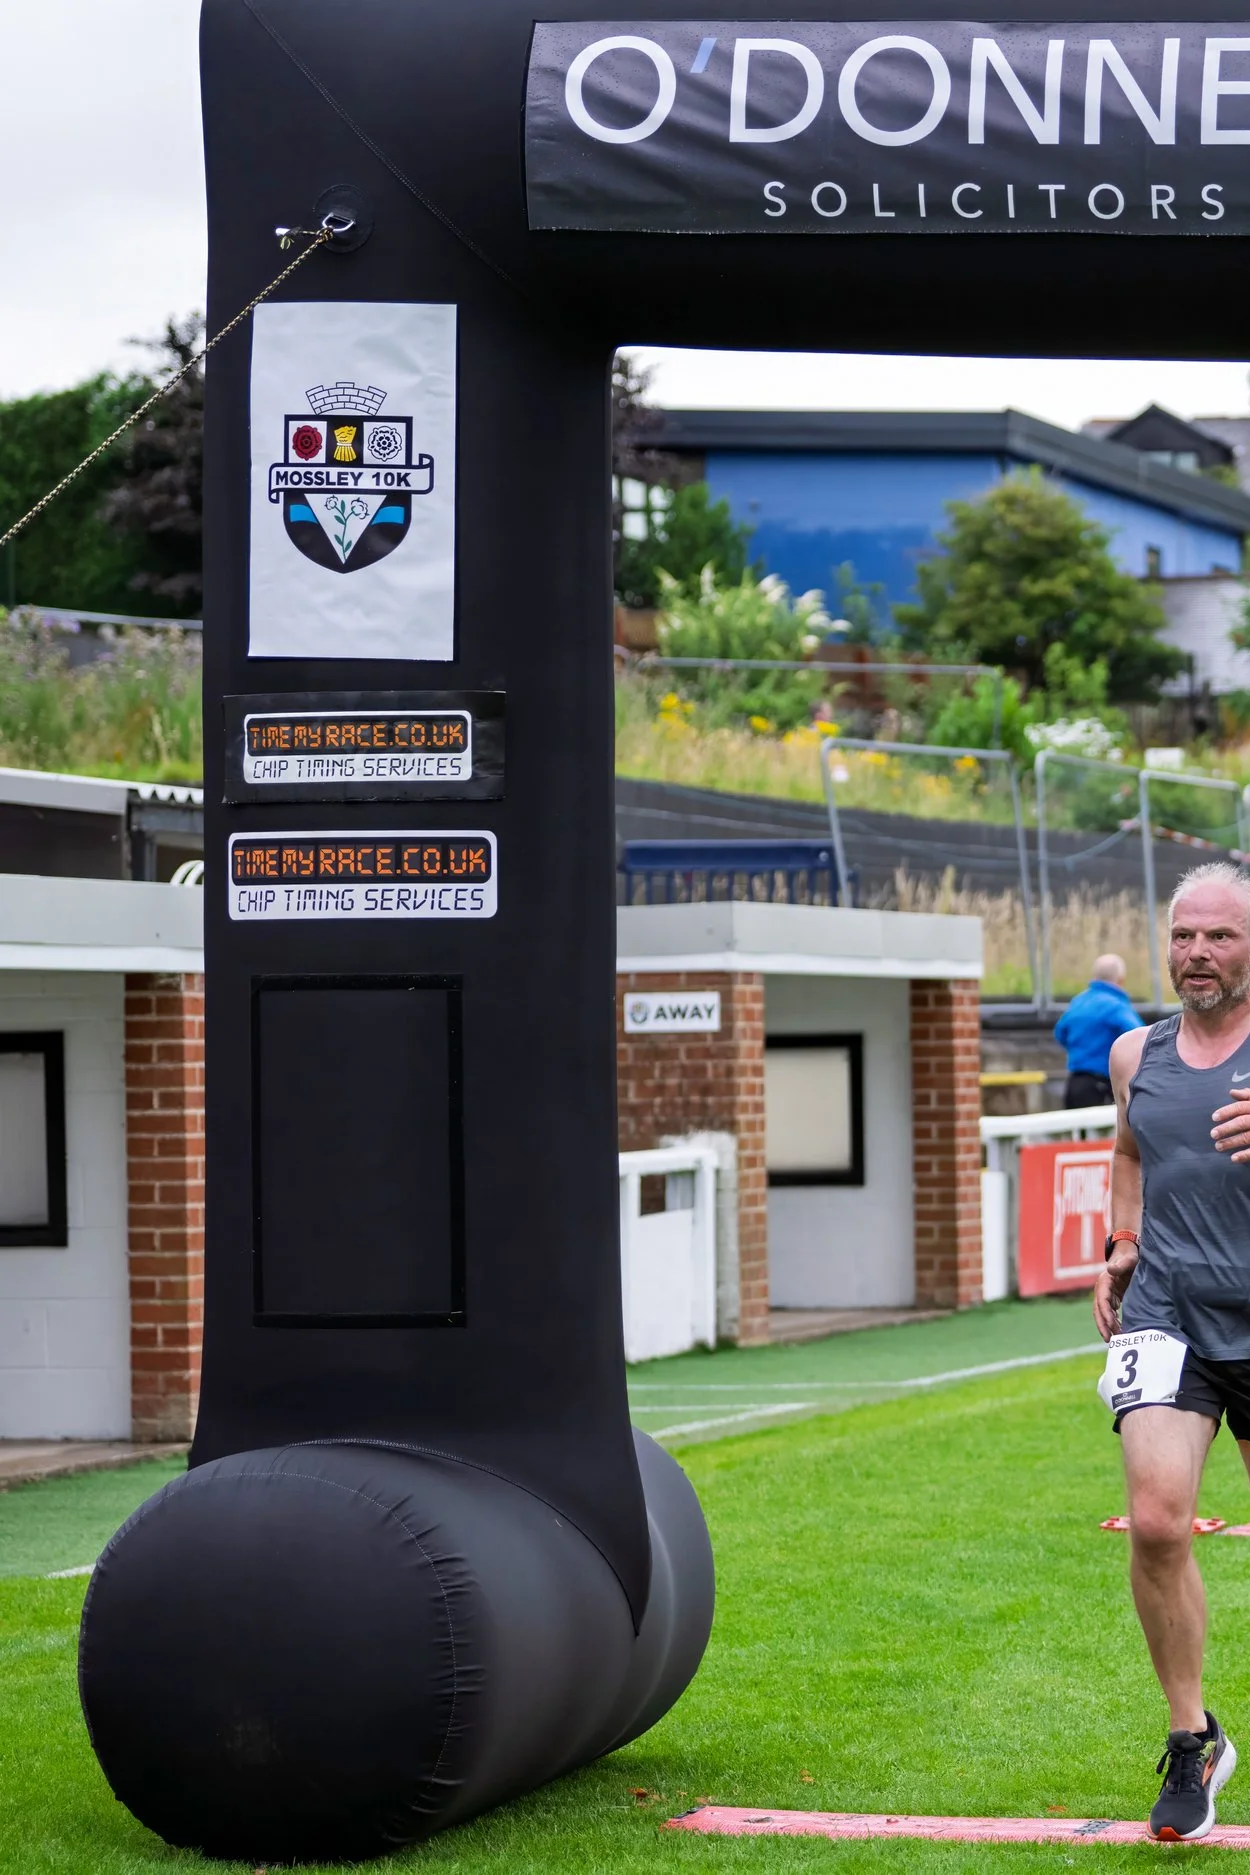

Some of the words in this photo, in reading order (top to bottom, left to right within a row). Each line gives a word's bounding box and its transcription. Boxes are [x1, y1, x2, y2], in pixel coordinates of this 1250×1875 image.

[762, 180, 1226, 221] SOLICITORS
[275, 471, 363, 487] MOSSLEY
[371, 471, 412, 488] 10K
[253, 759, 289, 779] CHIP
[296, 758, 355, 778] TIMING
[362, 757, 462, 777] SERVICES
[237, 889, 276, 913] CHIP
[284, 888, 355, 911] TIMING
[364, 887, 485, 911] SERVICES
[654, 1003, 715, 1020] AWAY
[1109, 1335, 1147, 1348] OSSLEY
[1149, 1334, 1167, 1342] 10K
[1117, 1349, 1138, 1388] 3
